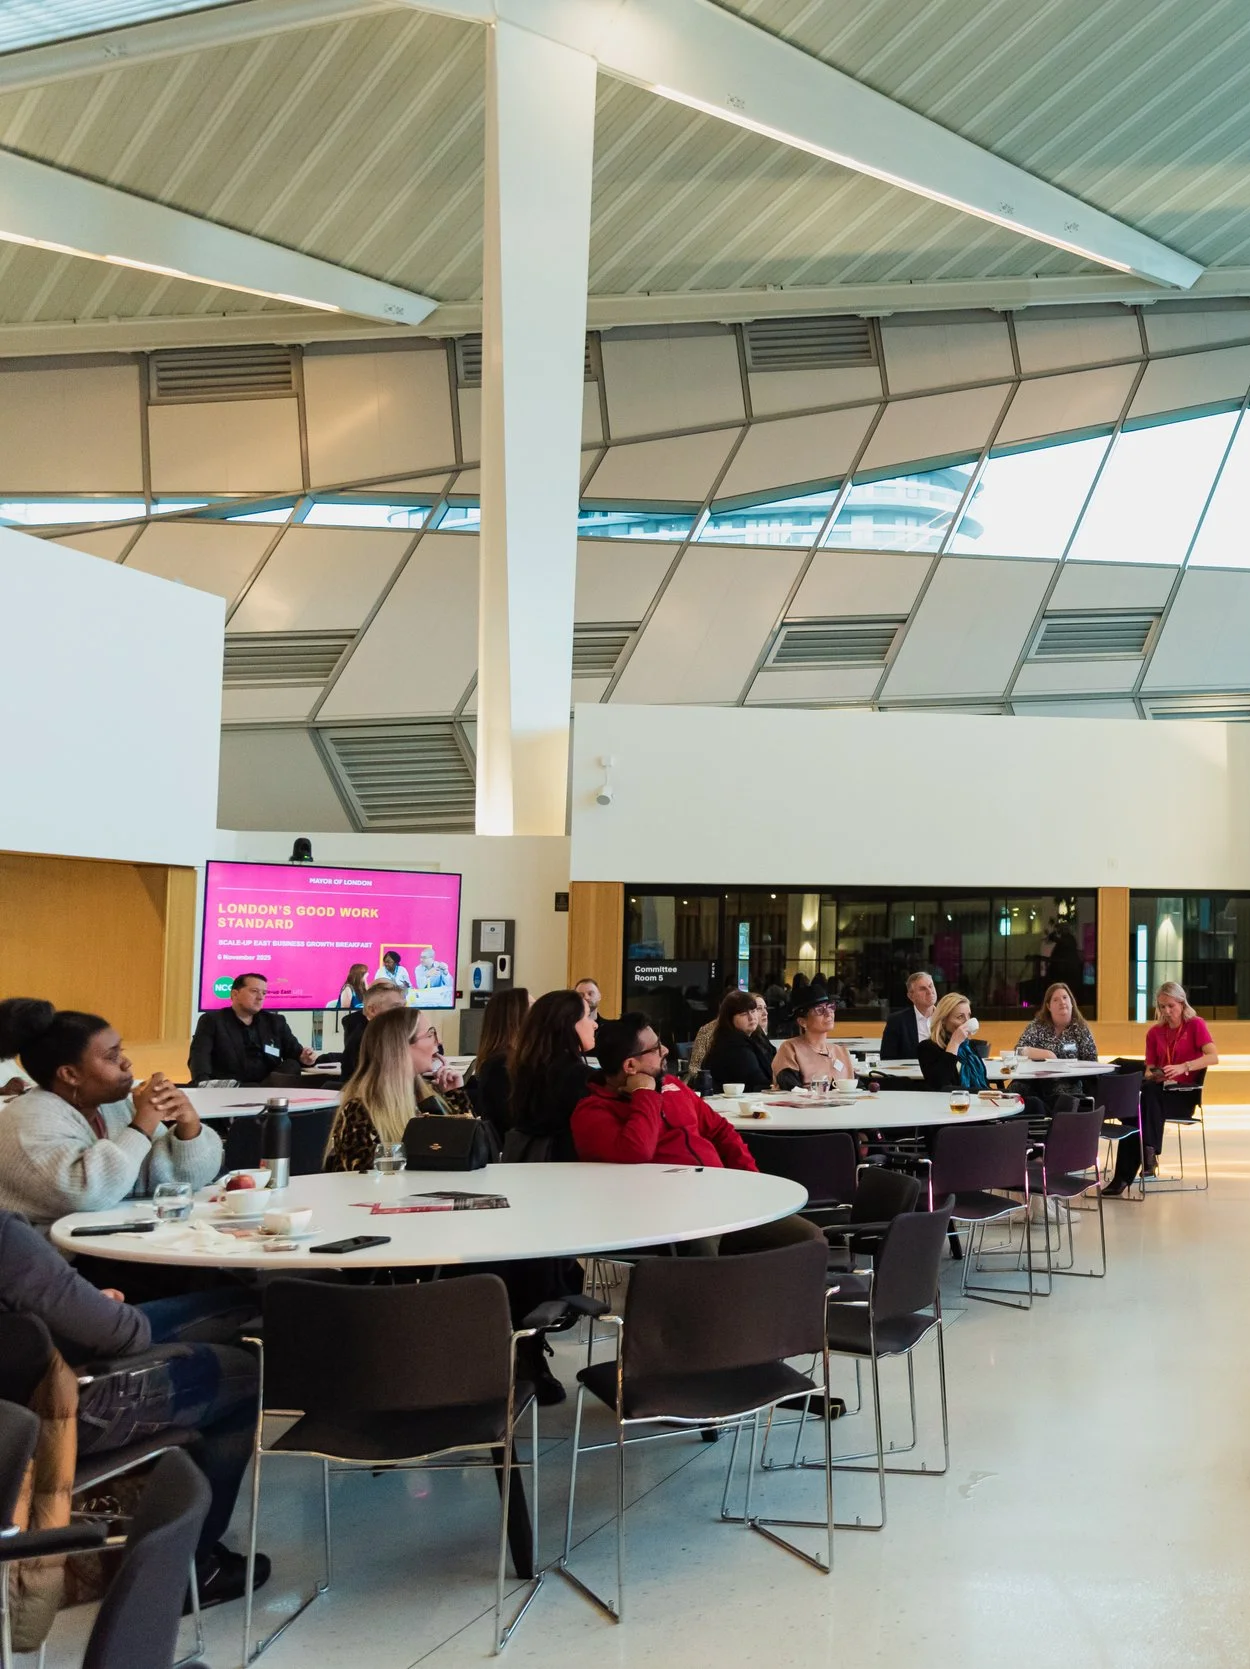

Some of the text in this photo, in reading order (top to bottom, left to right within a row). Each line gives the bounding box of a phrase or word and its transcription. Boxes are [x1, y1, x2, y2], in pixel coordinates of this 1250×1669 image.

[218, 903, 379, 918] LONDON'S GOOD WORK
[218, 918, 294, 929] STANDARD
